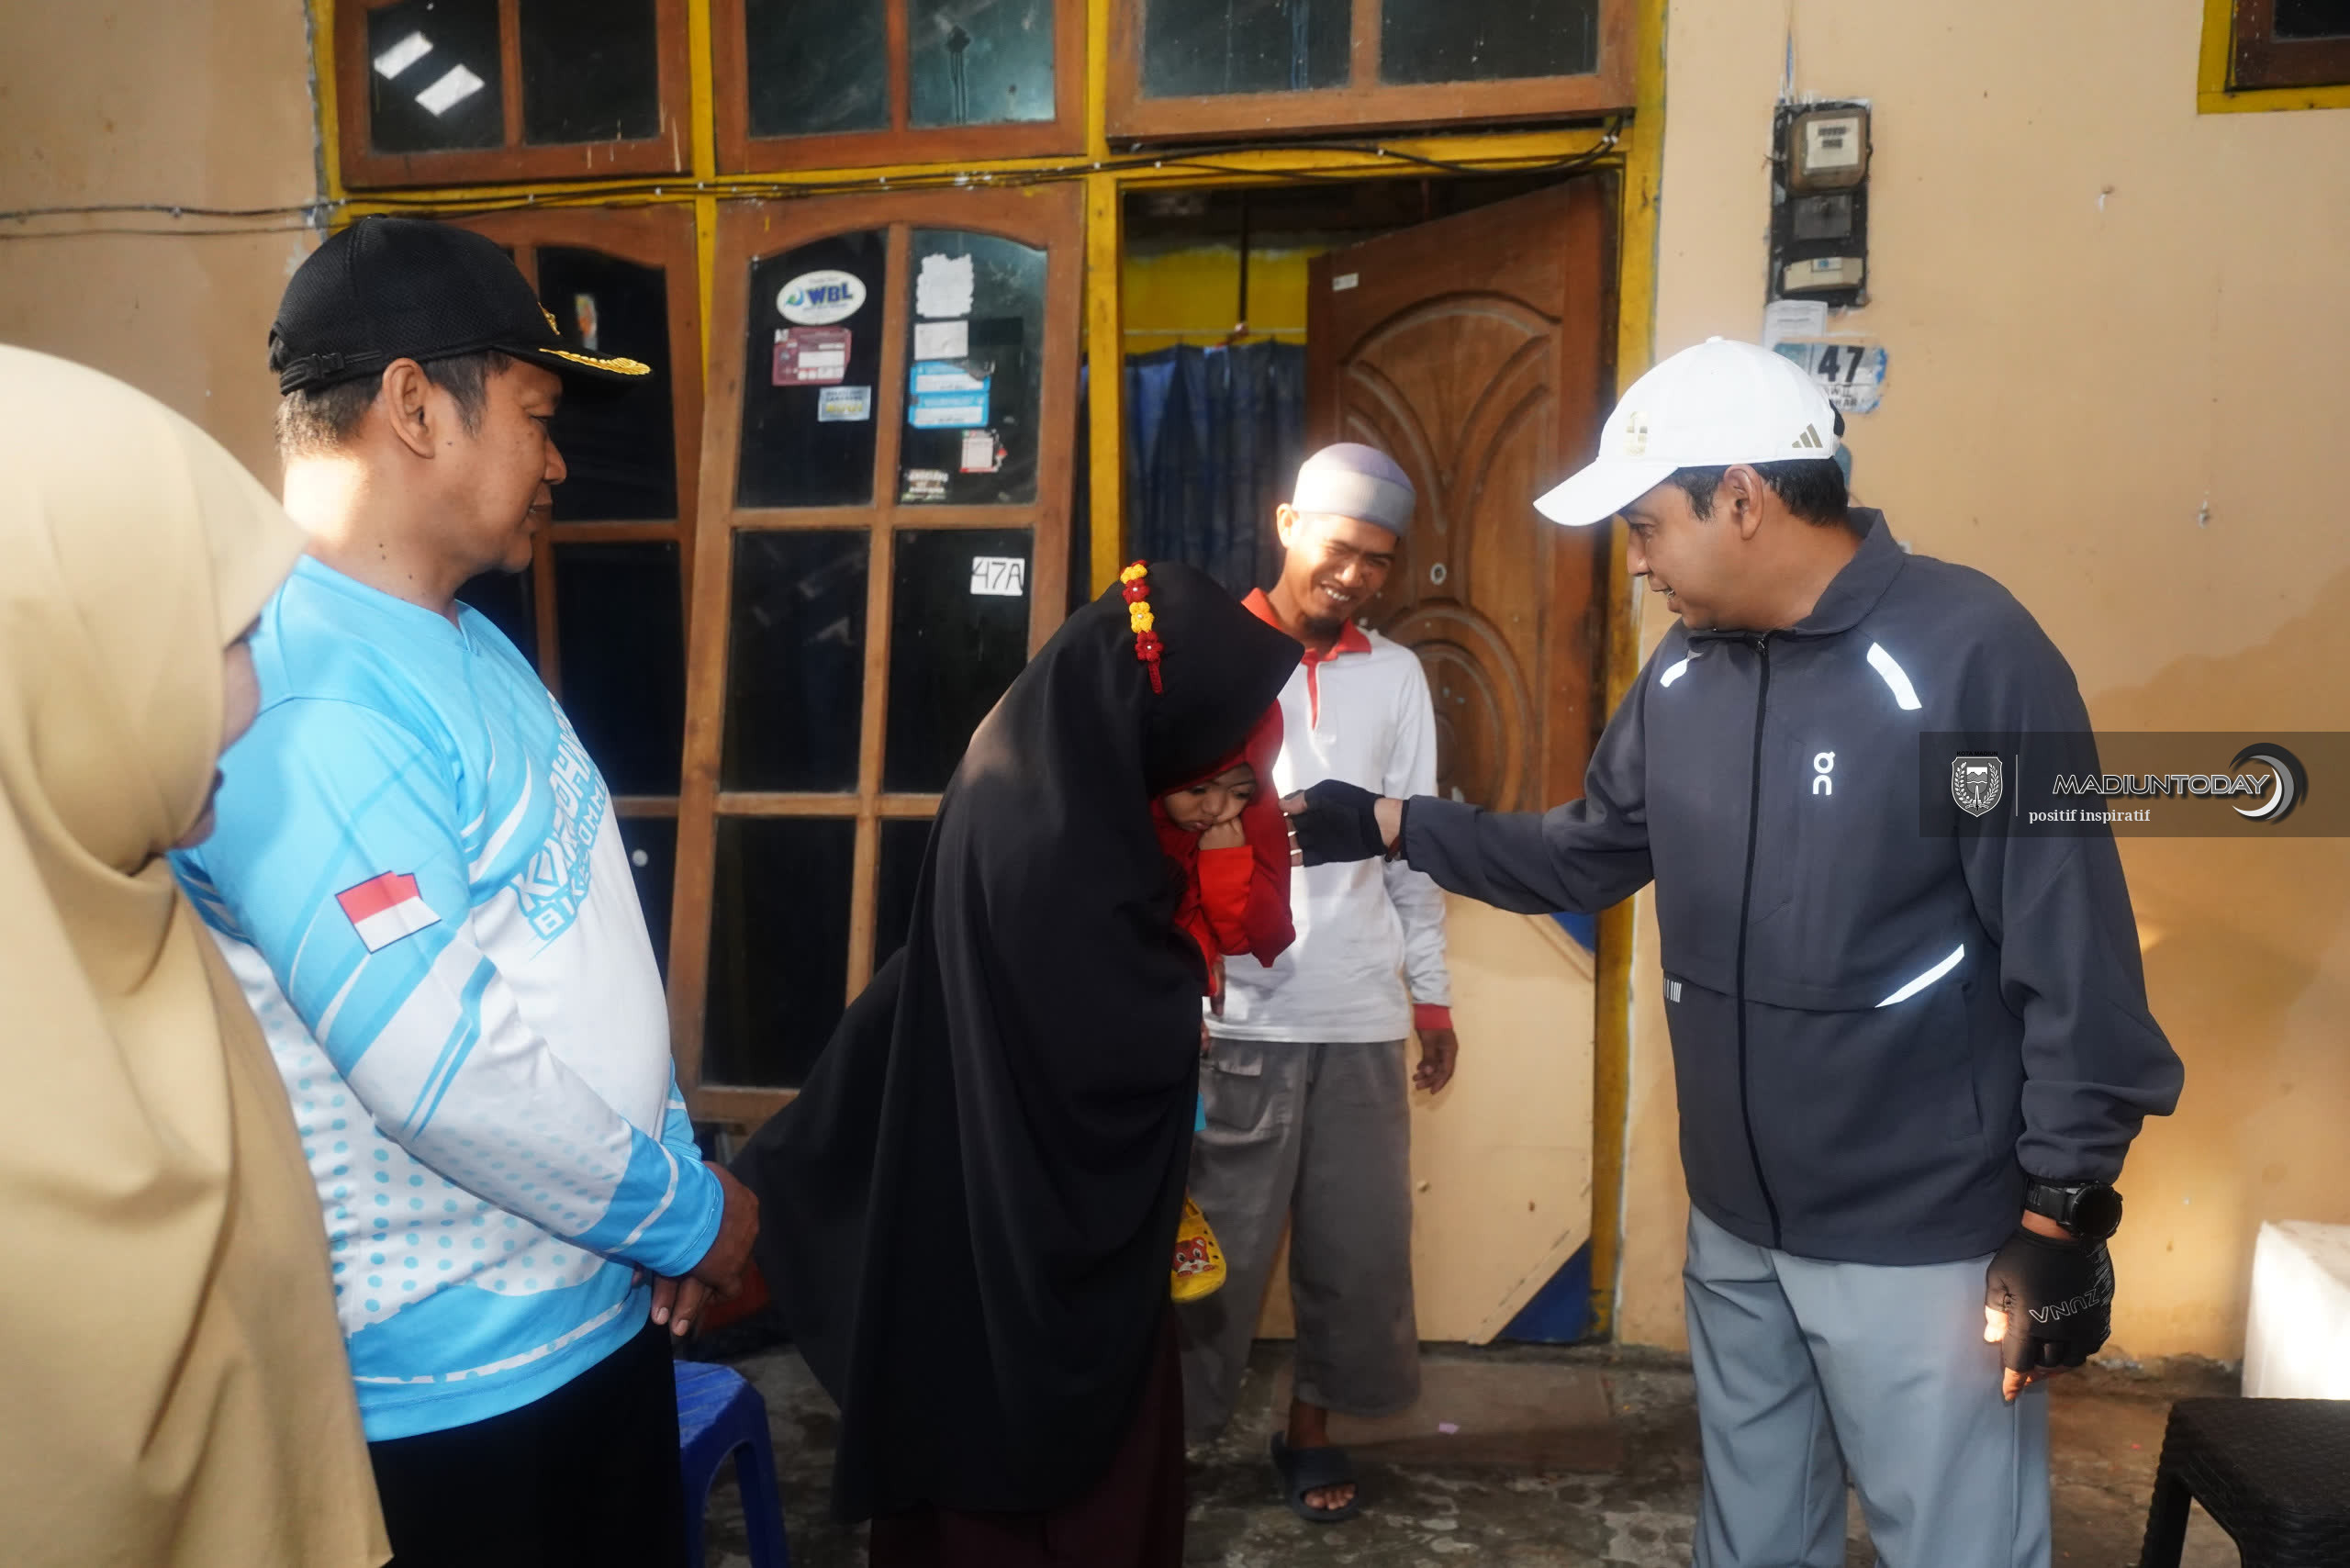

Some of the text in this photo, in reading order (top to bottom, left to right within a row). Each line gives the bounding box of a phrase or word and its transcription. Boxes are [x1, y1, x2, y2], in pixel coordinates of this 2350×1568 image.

[806, 281, 854, 306] WBL
[1818, 344, 1865, 383] 47
[971, 557, 1024, 590] 47A
